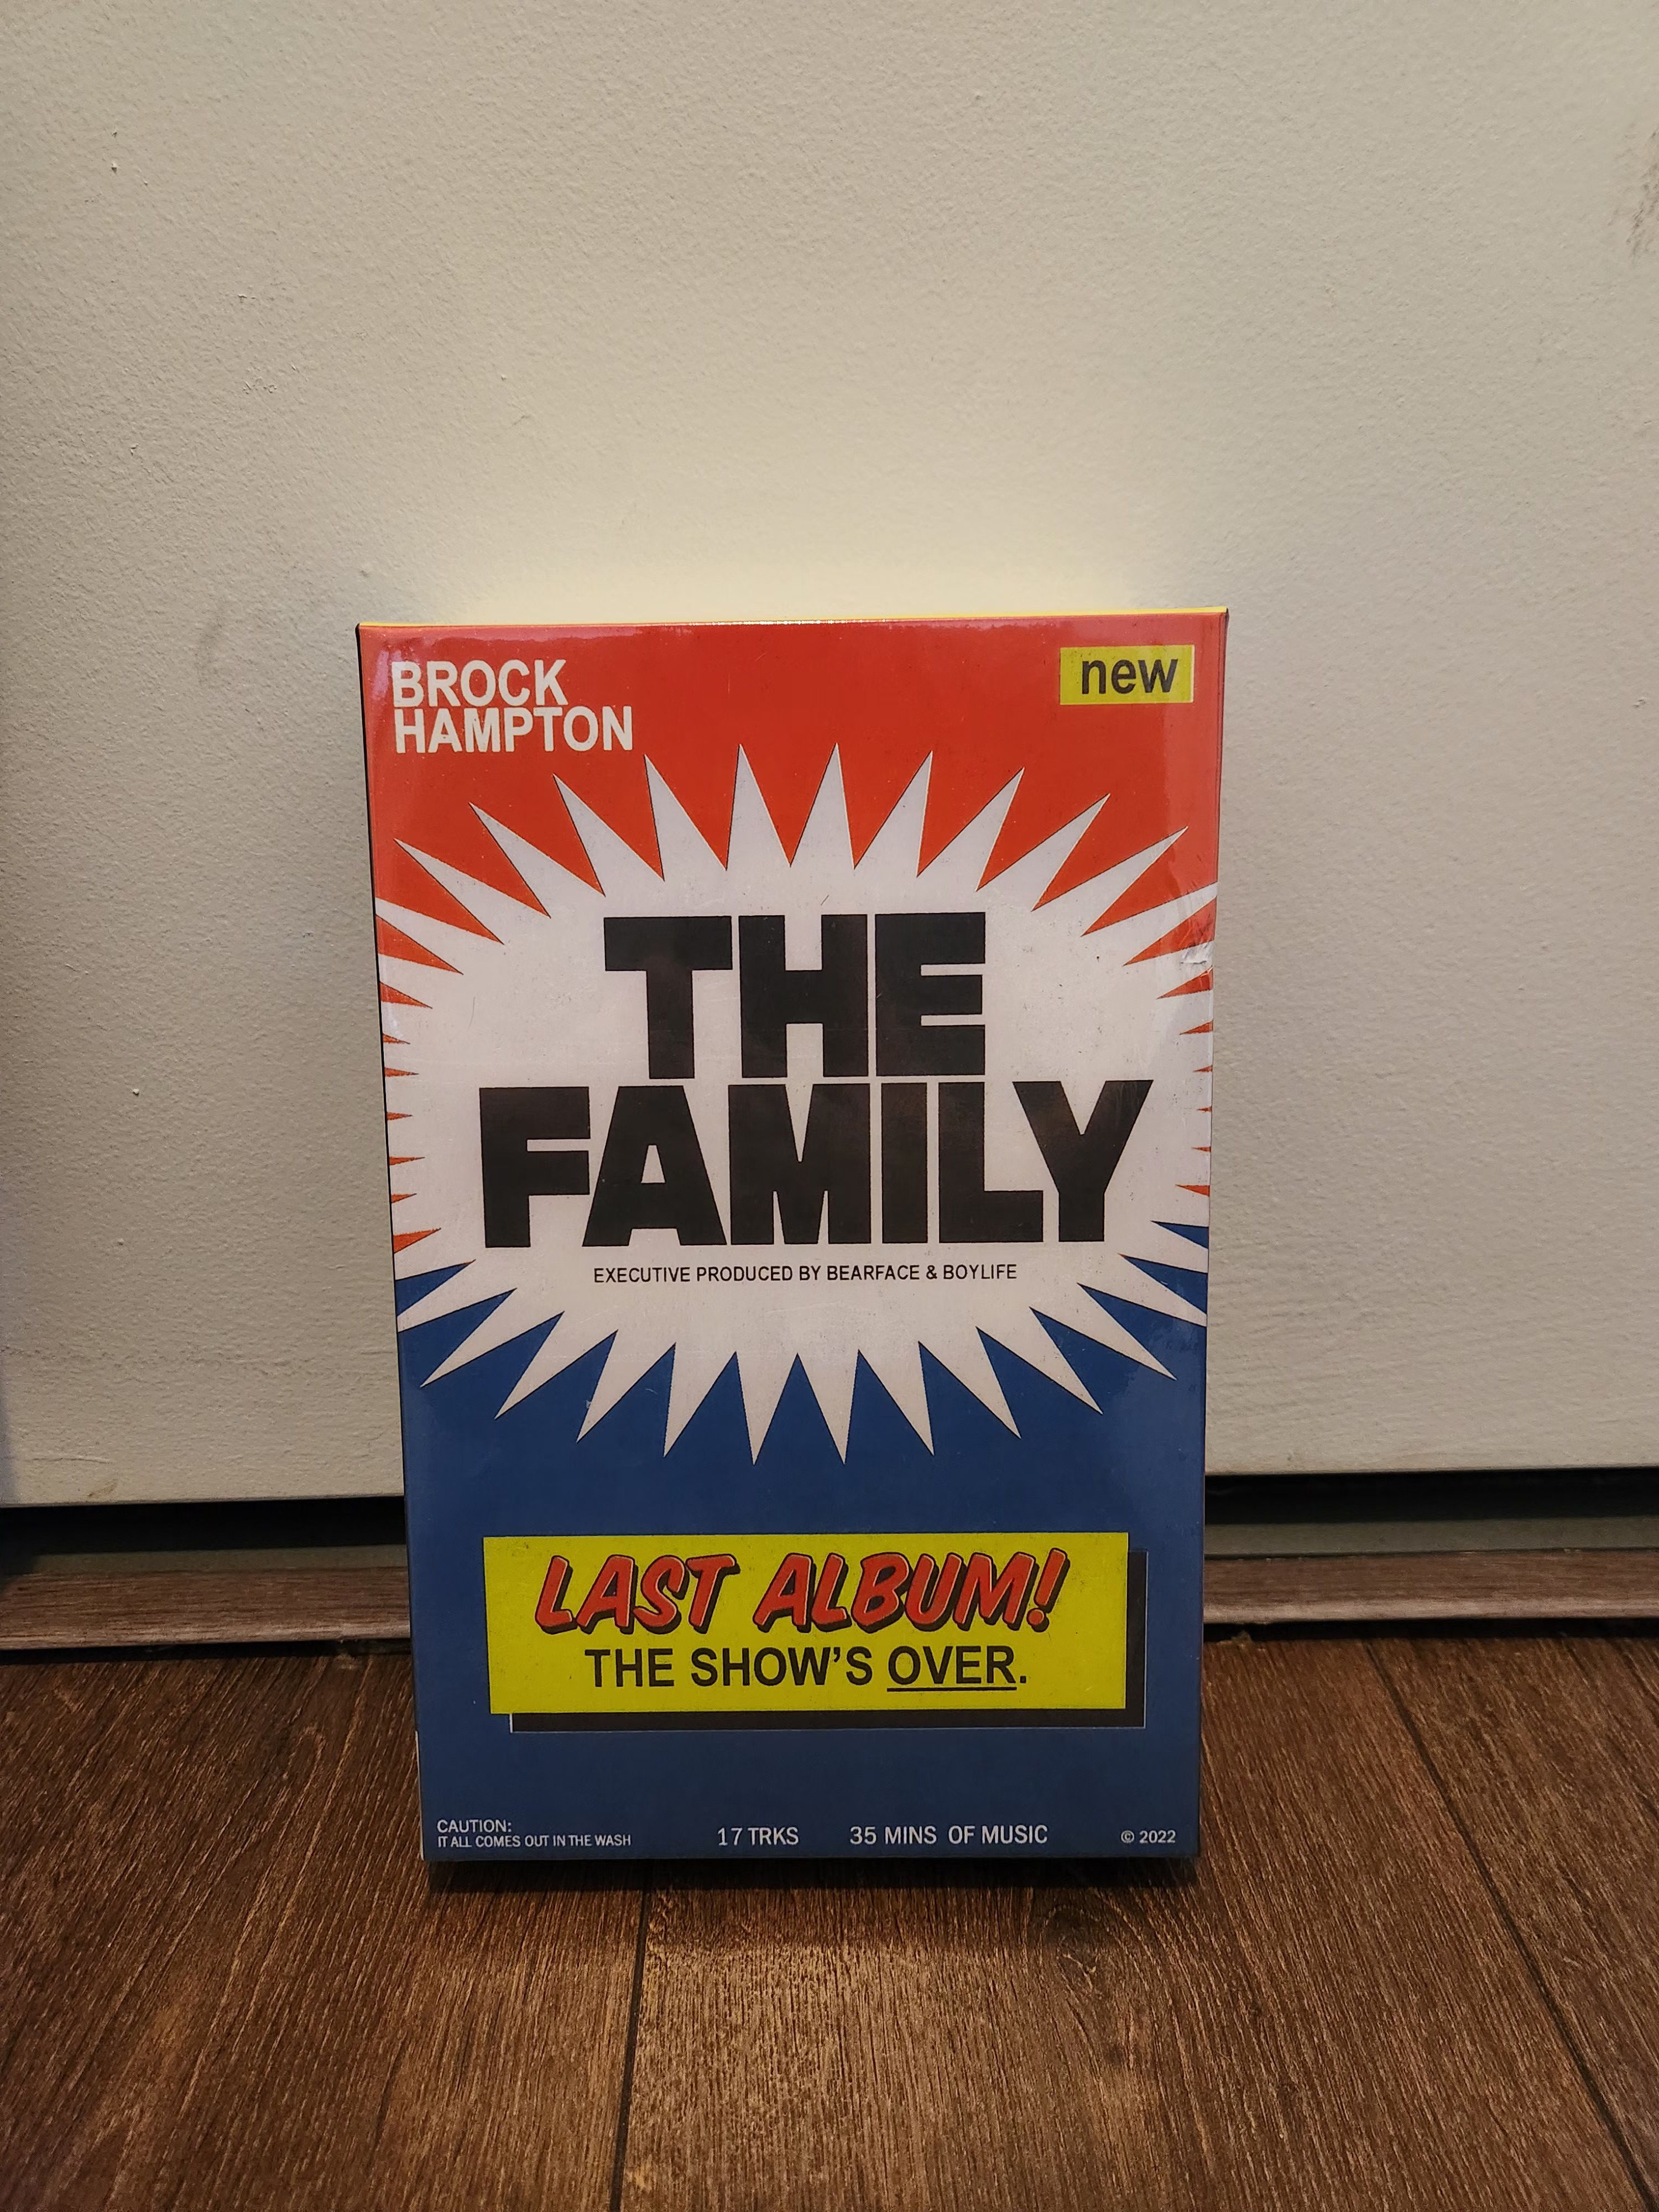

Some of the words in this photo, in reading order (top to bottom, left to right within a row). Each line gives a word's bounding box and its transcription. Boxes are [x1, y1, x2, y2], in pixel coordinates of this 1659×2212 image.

[390, 659, 569, 707] BROCK
[1082, 658, 1178, 695] new
[394, 706, 633, 753] HAMPTON
[603, 912, 986, 1079] THE
[479, 1079, 1154, 1248] FAMILY
[593, 1267, 691, 1283] EXECUTIVE
[696, 1266, 793, 1282] PRODUCED
[799, 1266, 821, 1281] BY
[827, 1265, 920, 1281] BEARFACE
[926, 1264, 938, 1280] &
[943, 1264, 1018, 1280] BOYLIFE
[534, 1554, 740, 1635] LAST
[753, 1547, 1071, 1634] ALBUM!
[584, 1647, 675, 1688] THE
[887, 1645, 1027, 1686] OVER.
[437, 1819, 512, 1833] CAUTION:
[437, 1835, 449, 1848] IT
[451, 1835, 472, 1848] ALL
[475, 1834, 521, 1848] COMES
[524, 1834, 550, 1848] OUT
[554, 1834, 566, 1847] IN
[568, 1834, 593, 1847] THE
[595, 1834, 632, 1846] WASH
[717, 1827, 742, 1845] 17
[748, 1827, 799, 1845] TRKS
[849, 1826, 877, 1844] 35
[885, 1825, 937, 1844] MINS
[948, 1825, 975, 1844] OF
[982, 1824, 1048, 1844] MUSIC
[1139, 1829, 1177, 1844] 2022
